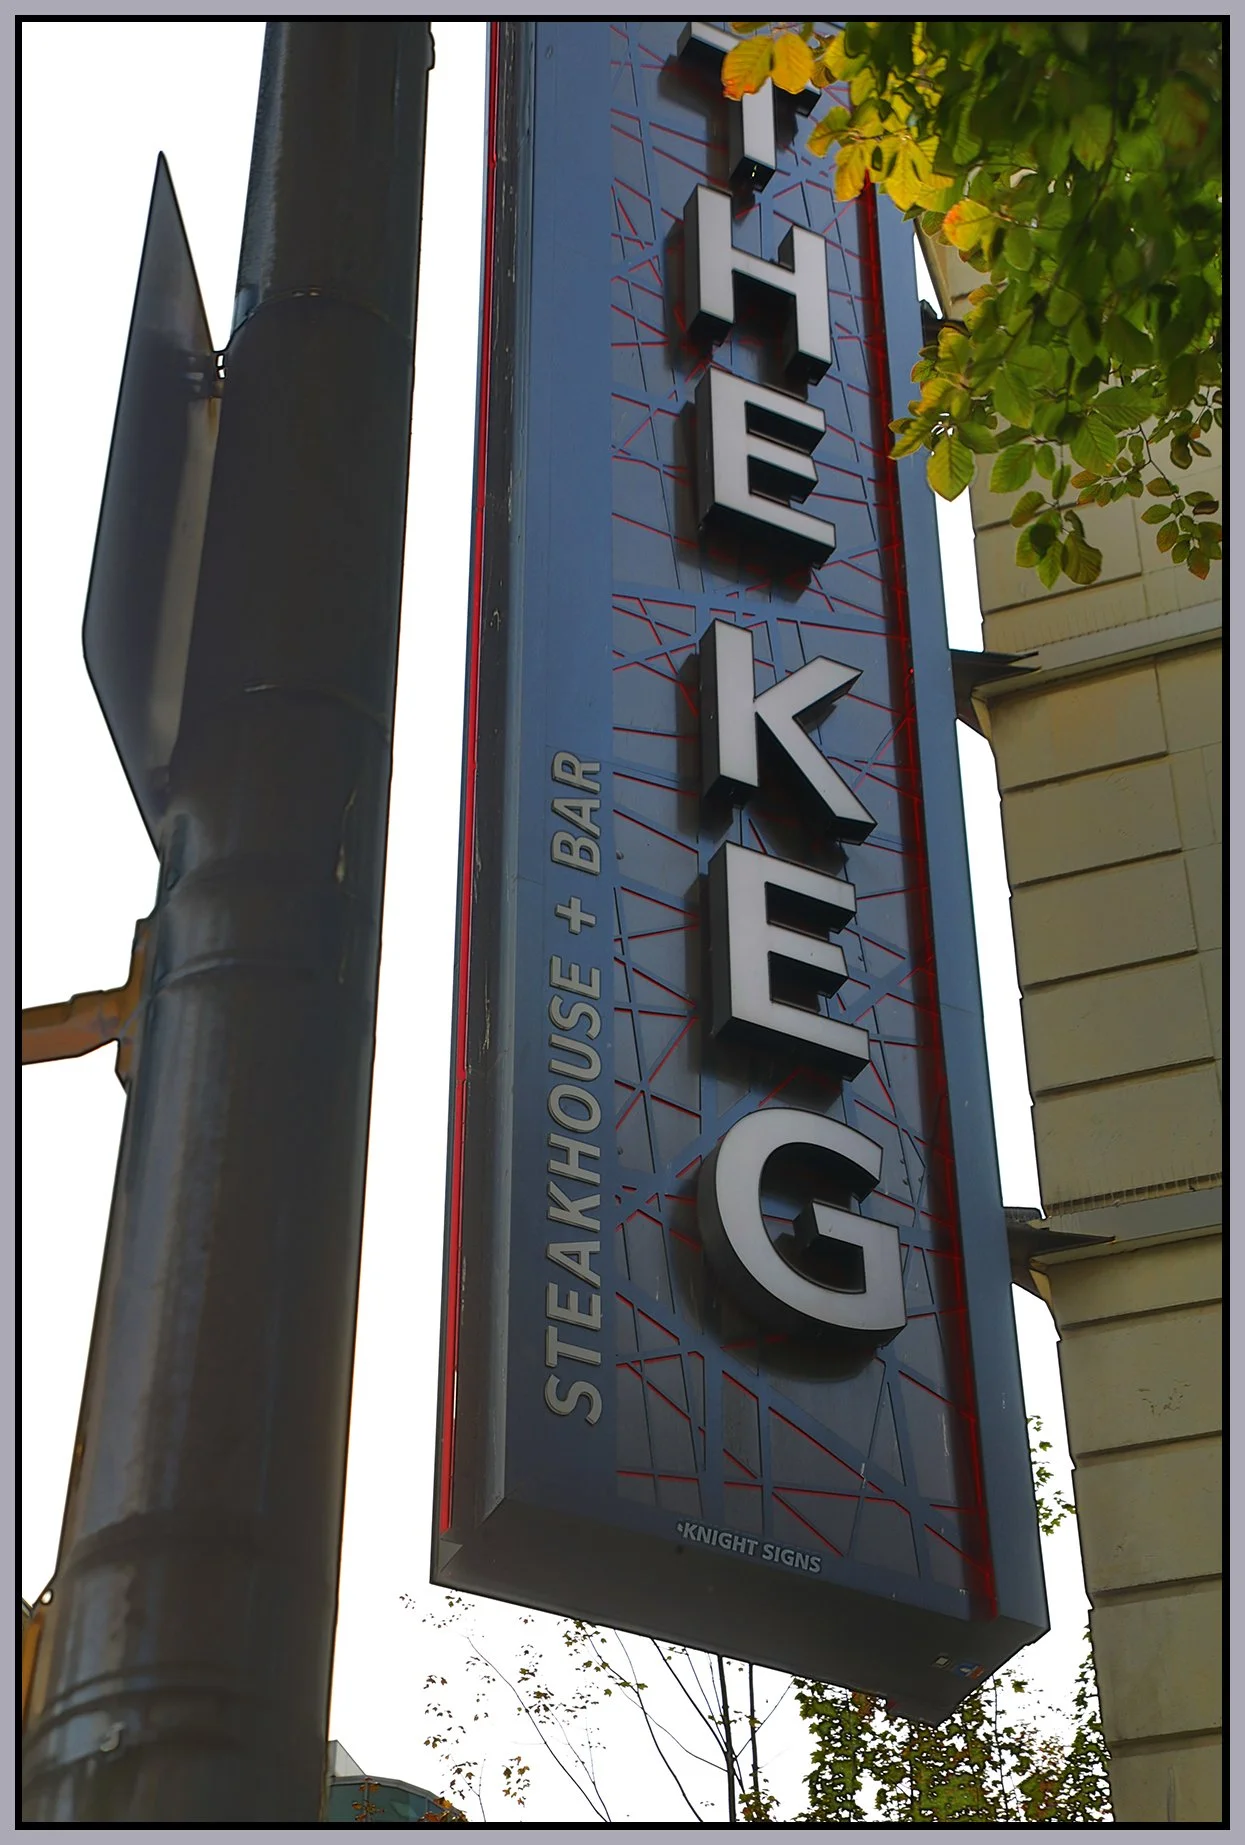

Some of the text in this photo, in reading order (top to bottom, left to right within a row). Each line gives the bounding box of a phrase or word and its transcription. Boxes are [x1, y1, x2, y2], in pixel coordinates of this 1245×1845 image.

[544, 749, 603, 1426] STEAKHOUSE + BAR
[702, 618, 909, 1337] KEG
[682, 1521, 822, 1574] KNIGHT SIGNS
